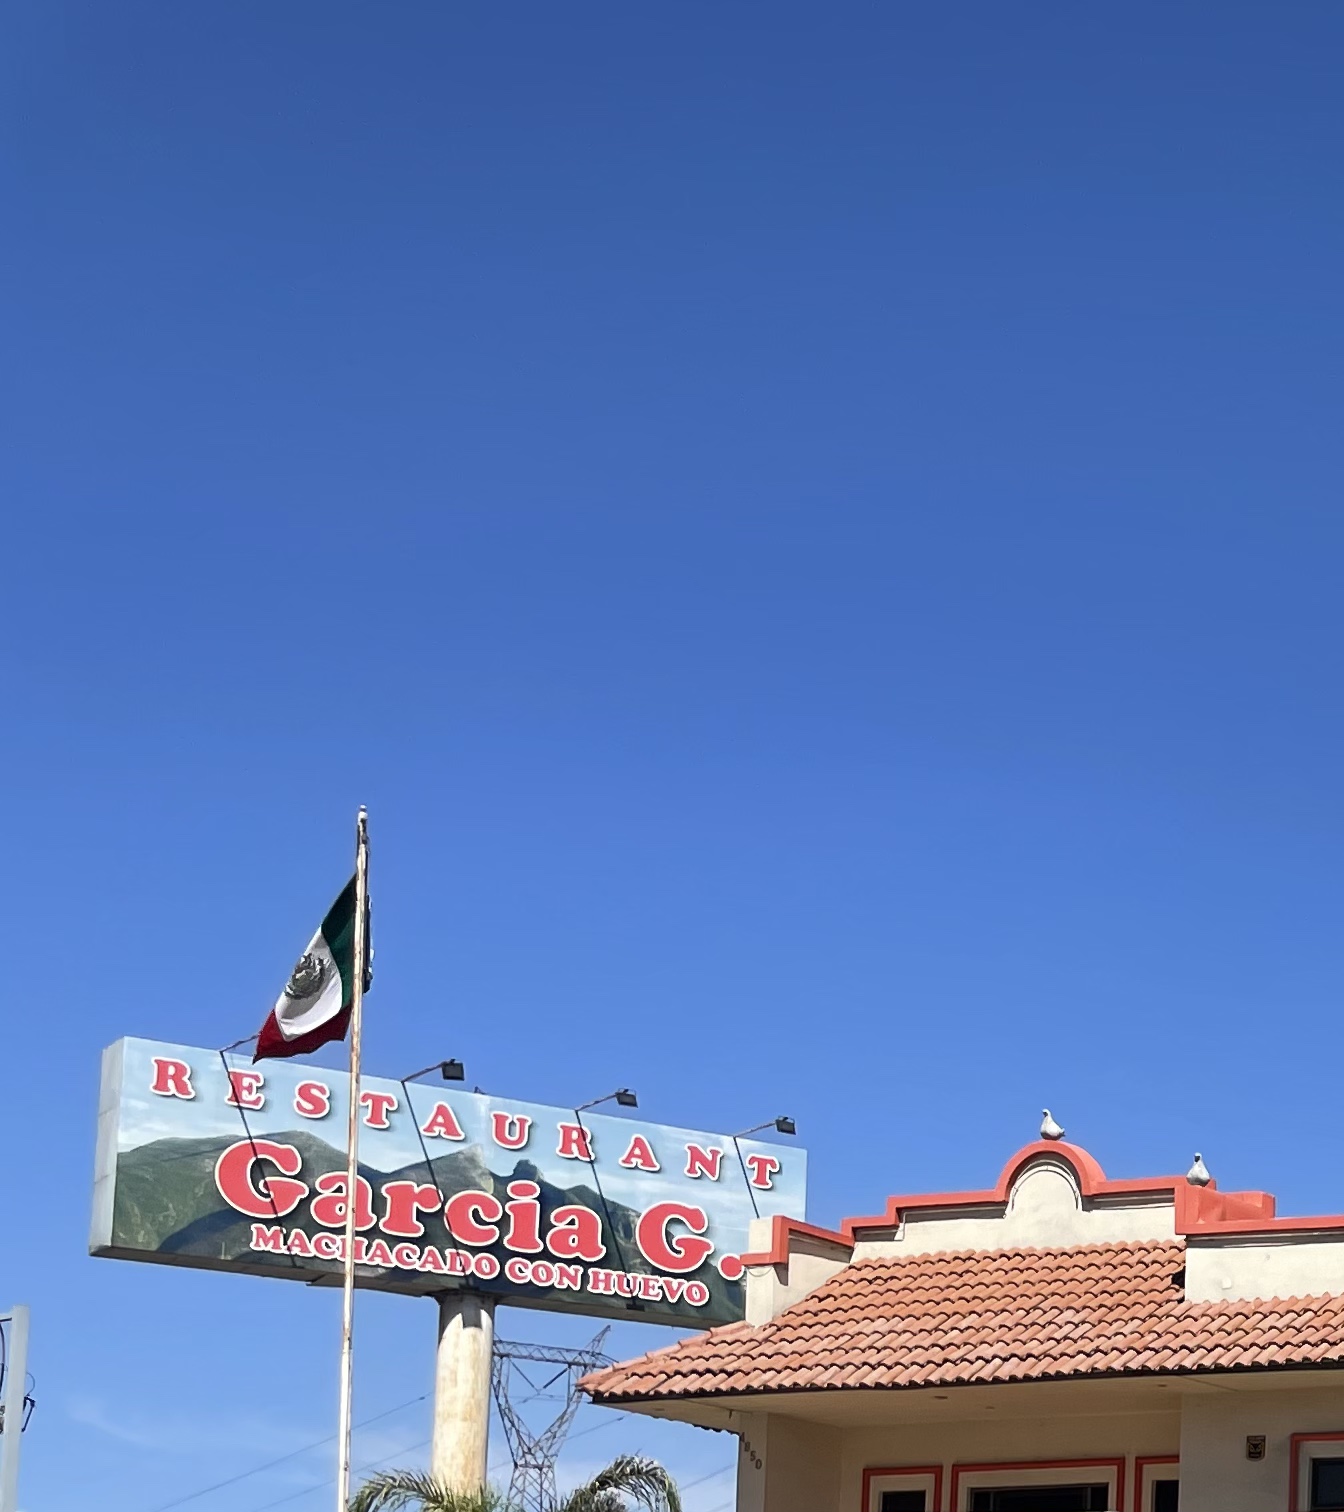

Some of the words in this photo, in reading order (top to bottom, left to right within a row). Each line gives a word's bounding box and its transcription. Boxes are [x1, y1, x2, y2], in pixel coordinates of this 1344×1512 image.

[152, 1057, 781, 1190] RESTAURANT
[214, 1138, 606, 1263] Garcia
[636, 1201, 746, 1281] G.
[249, 1223, 500, 1281] MACHACADO
[504, 1257, 580, 1292] CON
[585, 1268, 710, 1308] HUEVO
